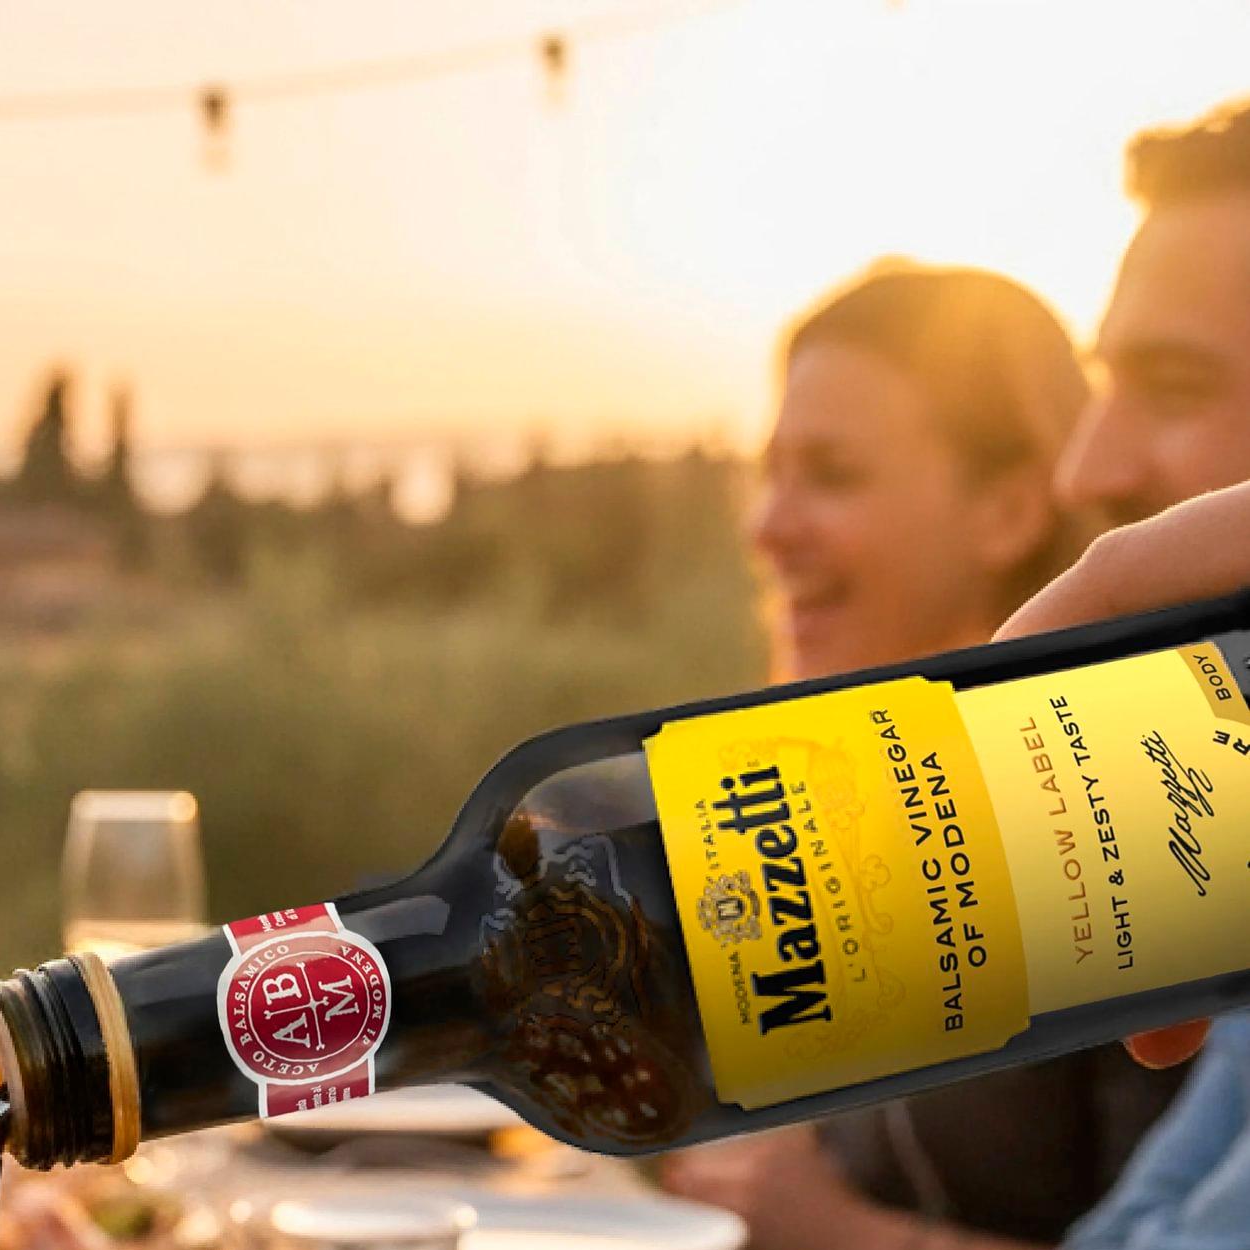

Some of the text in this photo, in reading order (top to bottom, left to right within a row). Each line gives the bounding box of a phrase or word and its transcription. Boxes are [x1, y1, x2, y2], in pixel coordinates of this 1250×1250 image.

[1193, 655, 1232, 700] BODY
[712, 764, 833, 1037] Mazzetti
[871, 709, 963, 1031] BALSAMIC VINEGAR
[921, 752, 987, 968] OF MODENA
[1019, 716, 1093, 965] YELLOW LABEL
[1050, 695, 1133, 970] LIGHT & ZESTY TASTE
[234, 944, 319, 1075] ACETO BALSAMICO
[318, 975, 360, 1022] M
[341, 945, 383, 1020] MODENA
